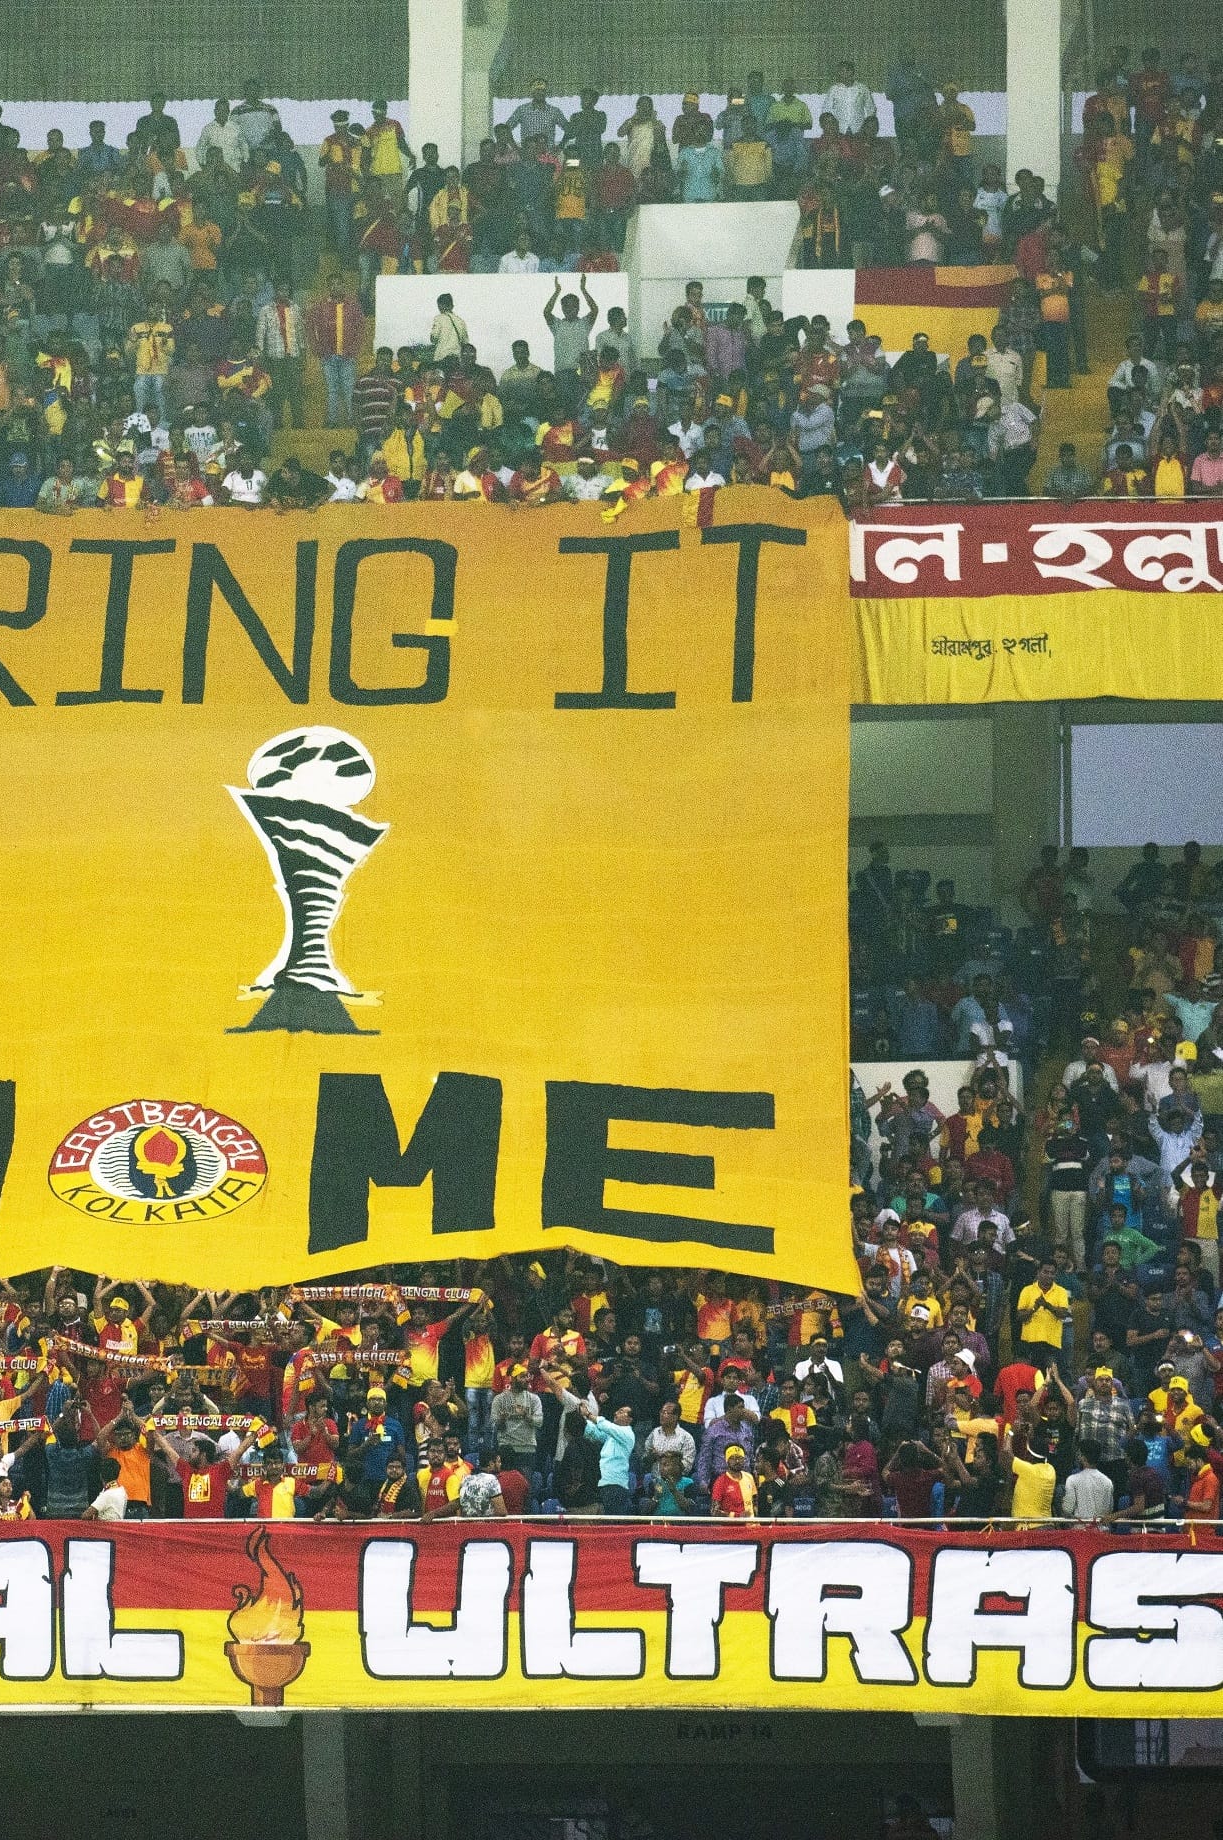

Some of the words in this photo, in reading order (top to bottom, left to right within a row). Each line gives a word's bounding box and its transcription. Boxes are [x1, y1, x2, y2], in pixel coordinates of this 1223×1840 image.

[555, 523, 807, 710] IT
[56, 1100, 259, 1168] EASTBENGAL
[61, 1177, 257, 1222] KOLKATA
[303, 1288, 334, 1298] EAST
[343, 1287, 387, 1298] BENGAL
[400, 1287, 441, 1298] BENGAL
[444, 1288, 470, 1299] CLUB
[200, 1320, 225, 1330] EAST
[228, 1320, 270, 1329] BENGAL
[313, 1352, 344, 1363] EAST
[354, 1352, 401, 1362] BENGAL
[10, 1359, 37, 1370] CLUB
[155, 1417, 179, 1428] EAST
[182, 1417, 223, 1427] BENGAL
[226, 1417, 252, 1428] CLUB
[247, 1466, 289, 1477] BENL
[291, 1466, 318, 1476] CLUB
[362, 1537, 1223, 1691] ULTRAS
[676, 1723, 742, 1740] RAMP
[749, 1723, 774, 1740] 14
